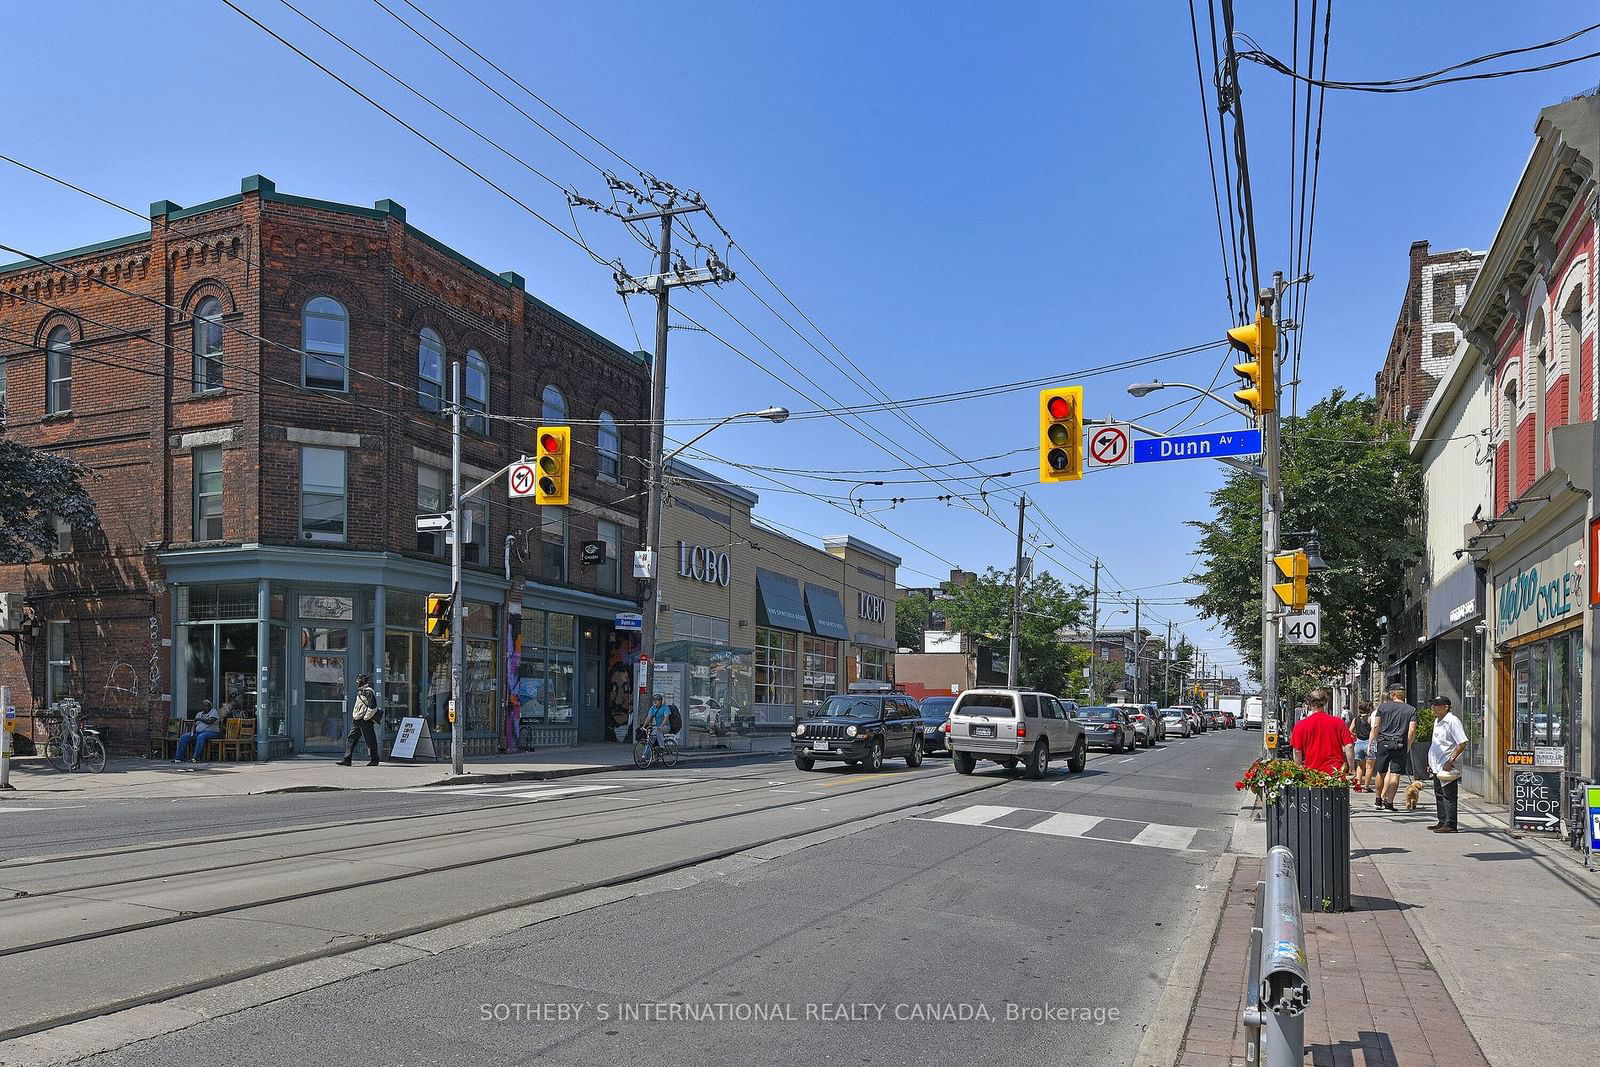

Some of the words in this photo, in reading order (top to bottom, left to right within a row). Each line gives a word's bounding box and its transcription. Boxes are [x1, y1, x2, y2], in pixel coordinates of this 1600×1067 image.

[1160, 440, 1211, 457] Dunn
[1219, 435, 1233, 445] Av
[677, 540, 731, 588] LCBO
[858, 592, 887, 624] LCBO
[1498, 567, 1539, 632] Metro
[1537, 572, 1571, 623] CYCLE
[1288, 621, 1317, 639] 40
[1507, 755, 1533, 765] OPEN
[1516, 786, 1548, 799] BIKE
[1515, 799, 1559, 813] SHOP
